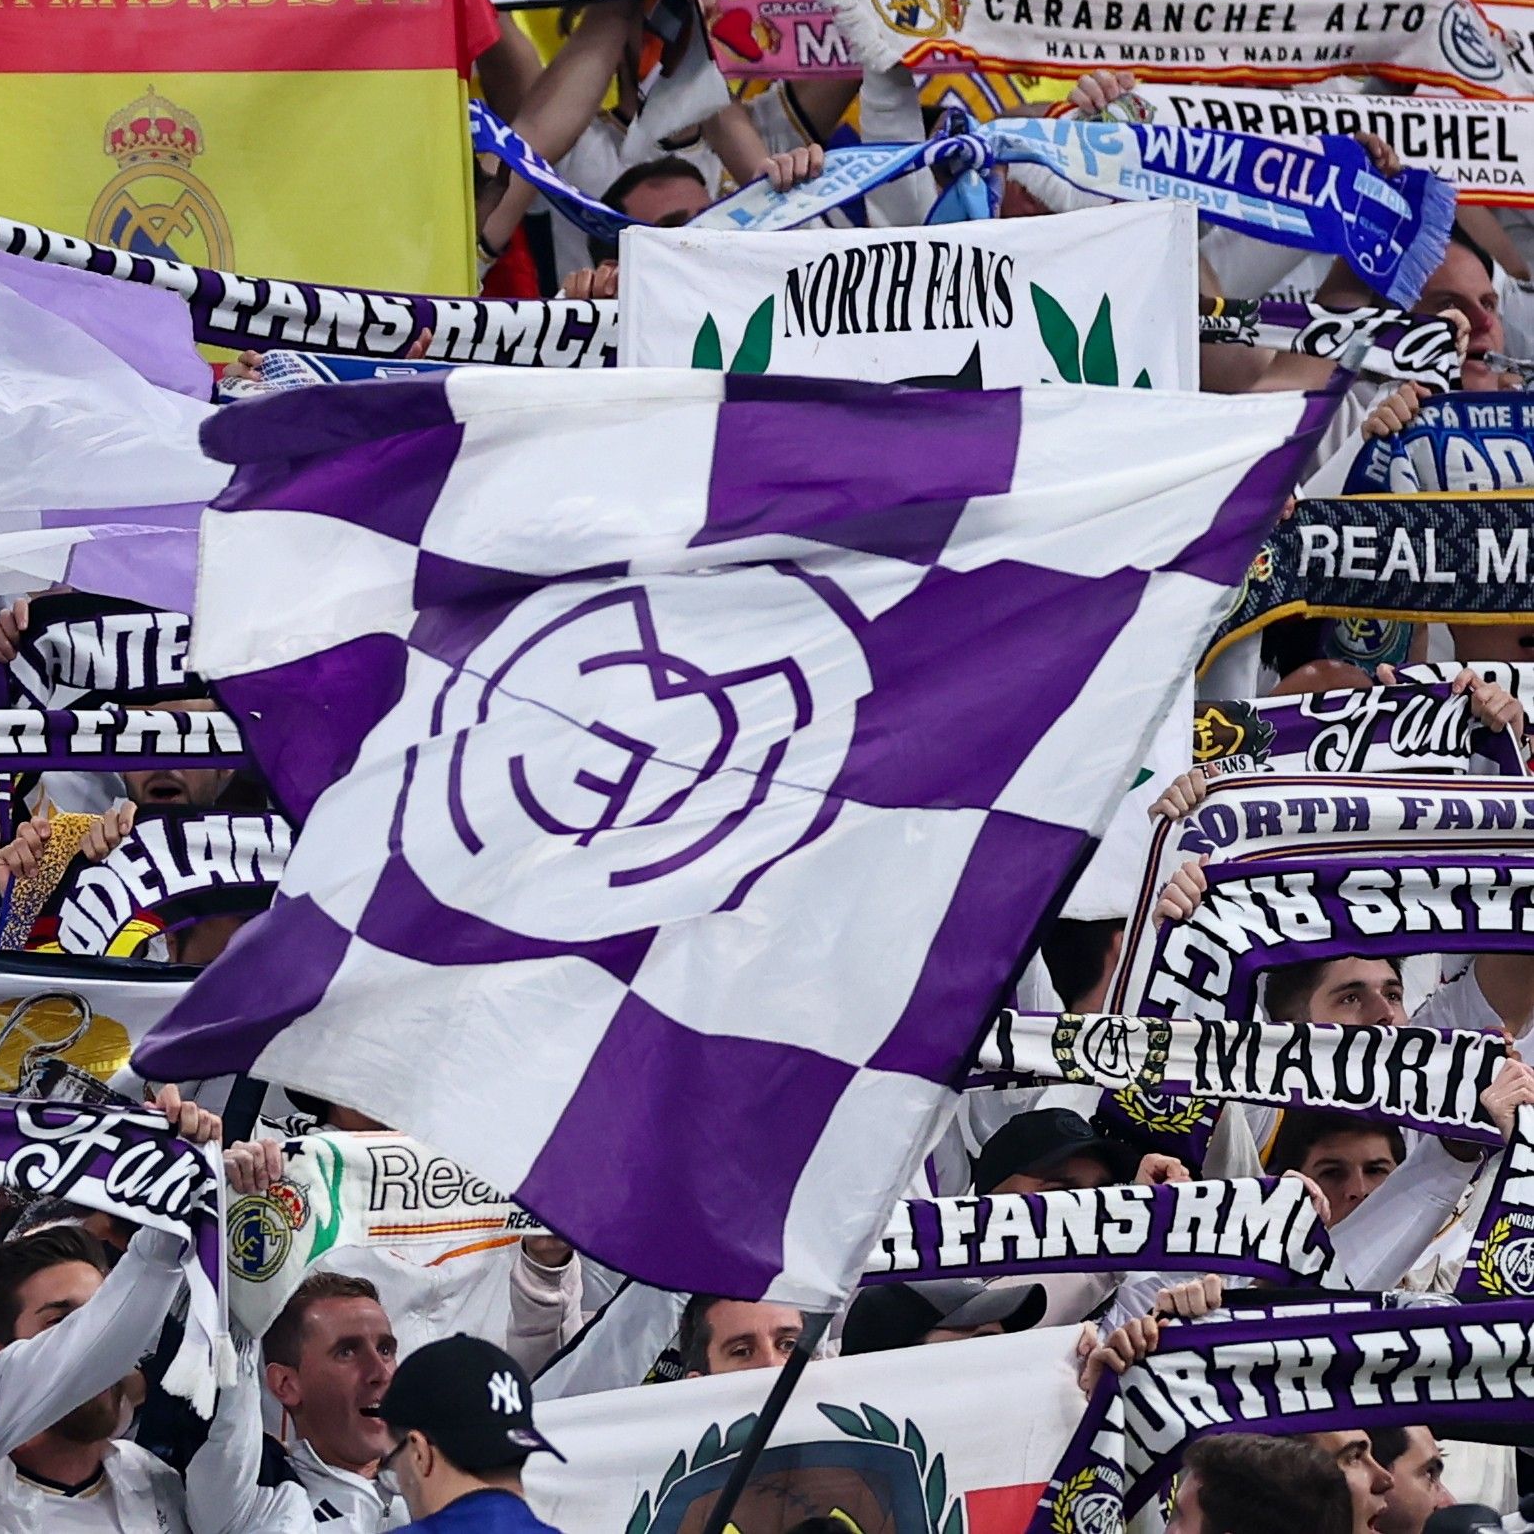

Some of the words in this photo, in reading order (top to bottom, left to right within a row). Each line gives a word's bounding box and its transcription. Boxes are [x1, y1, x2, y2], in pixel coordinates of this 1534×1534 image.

[1327, 0, 1428, 34] ALTO
[1047, 42, 1107, 61] HALA
[1121, 44, 1212, 62] MADRID
[1221, 44, 1234, 61] Y
[1246, 44, 1305, 63] NADA
[1317, 39, 1357, 62] MÁS
[1459, 167, 1528, 186] NADA
[207, 275, 419, 358] FANS
[784, 239, 916, 339] NORTH
[931, 240, 1018, 334] FANS
[1300, 525, 1458, 586] REAL
[933, 1185, 1157, 1264] FANS
